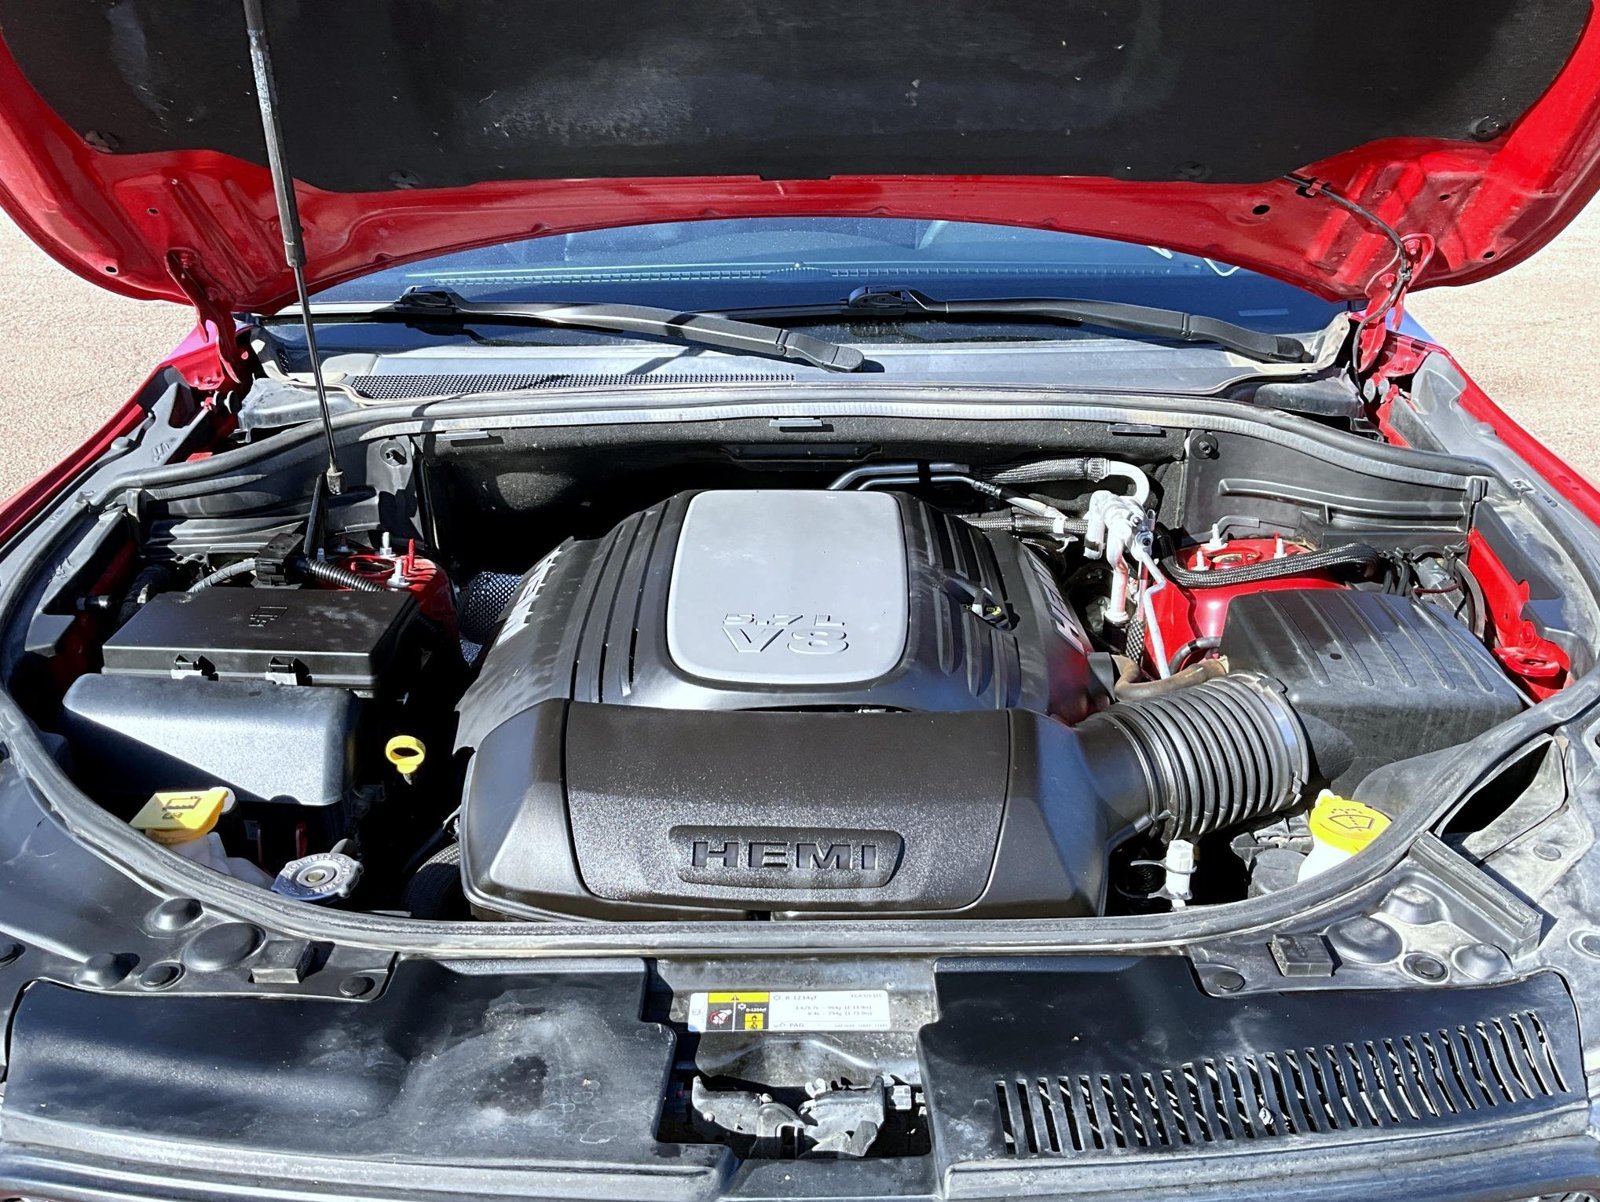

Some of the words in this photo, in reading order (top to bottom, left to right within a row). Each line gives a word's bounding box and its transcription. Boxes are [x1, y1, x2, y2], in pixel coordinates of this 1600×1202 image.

[1025, 551, 1087, 657] HEMI
[721, 628, 850, 655] V8
[692, 841, 878, 870] HEMI
